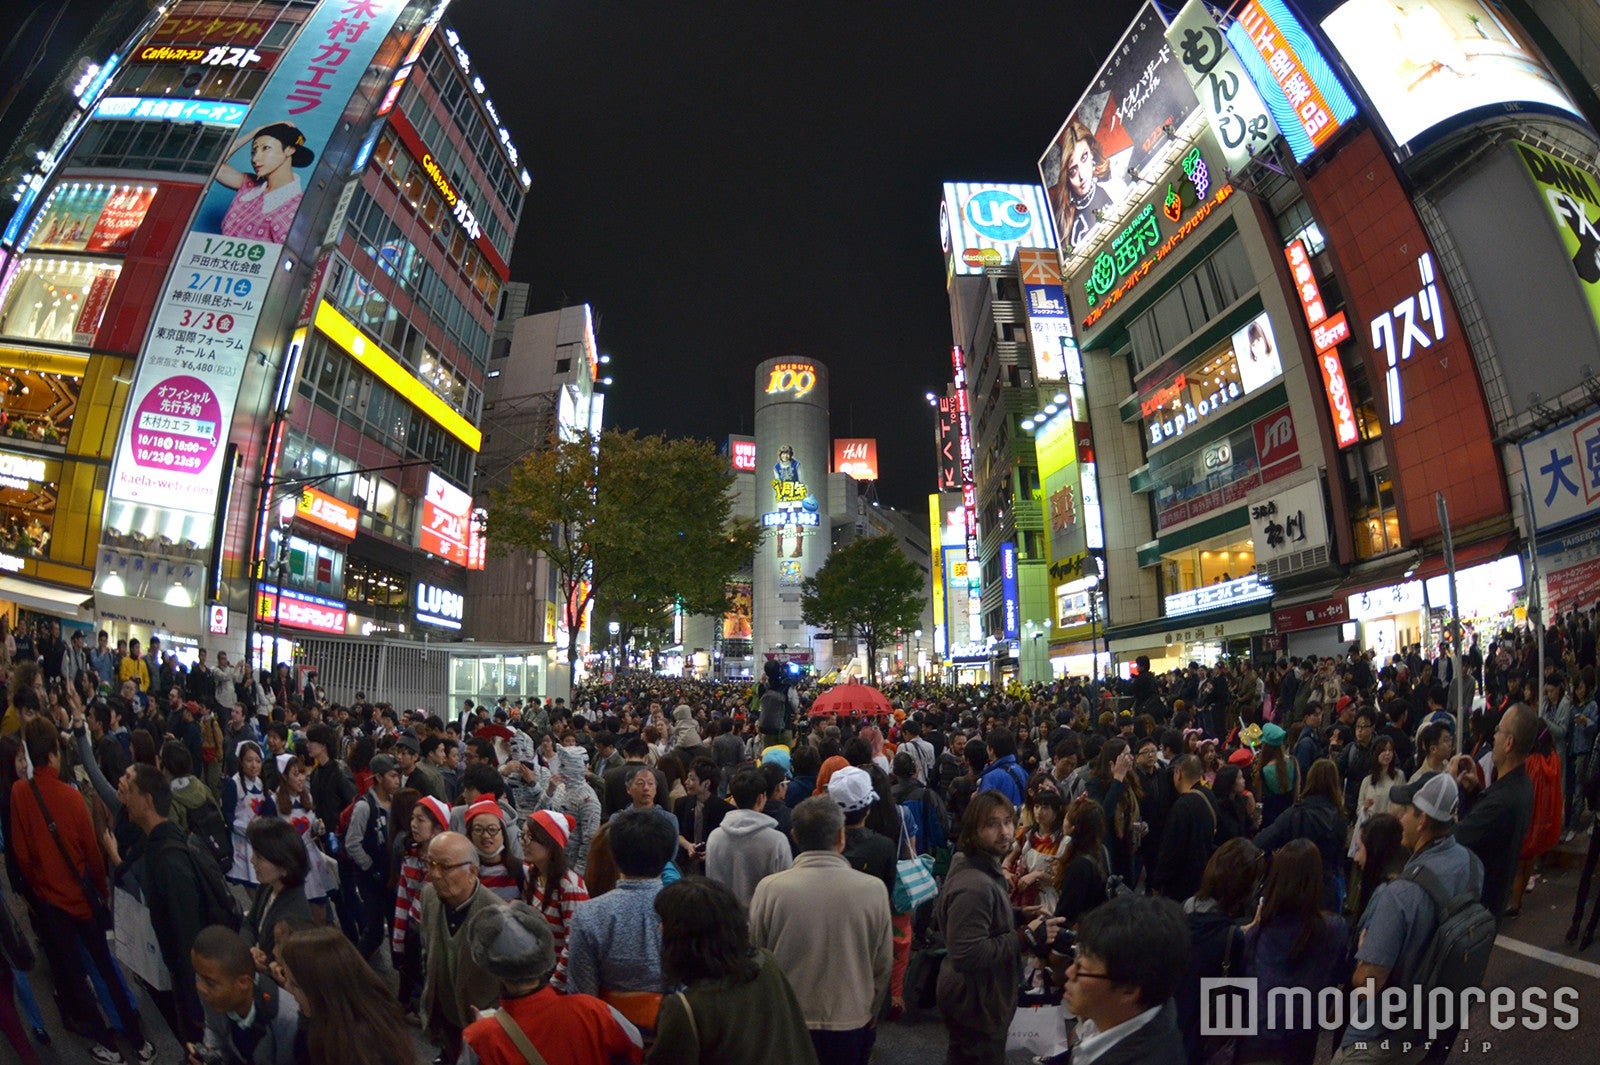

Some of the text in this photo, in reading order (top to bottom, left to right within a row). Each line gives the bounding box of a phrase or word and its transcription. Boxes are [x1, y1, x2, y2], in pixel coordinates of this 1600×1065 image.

[157, 18, 264, 39] コンタクト
[202, 46, 261, 67] ガスト
[286, 0, 383, 116] 木村カエラ
[1110, 44, 1171, 132] バイオハザード
[1183, 25, 1268, 149] もんじゃ
[453, 199, 481, 239] ガスト
[1115, 215, 1161, 276] 西村
[190, 255, 262, 275] 戸田市文化会館
[172, 290, 253, 312] 神奈川県民ホール
[155, 327, 244, 351] 東京国際フォーラム
[149, 355, 178, 369] 全席指定
[775, 364, 815, 372] SHIBUYA
[158, 385, 211, 403] オフィシャル
[765, 369, 816, 398] 109
[160, 399, 202, 417] 先行予約
[1150, 382, 1240, 444] Euphoria
[142, 414, 191, 433] 木村カエラ
[1262, 415, 1293, 459] JTB
[843, 443, 868, 459] H&M
[120, 472, 213, 496] kaela-web.com
[1051, 484, 1077, 530] 薬
[432, 506, 461, 540] アコム
[1561, 528, 1600, 548] TAISEIDO
[418, 582, 464, 620] LUSH
